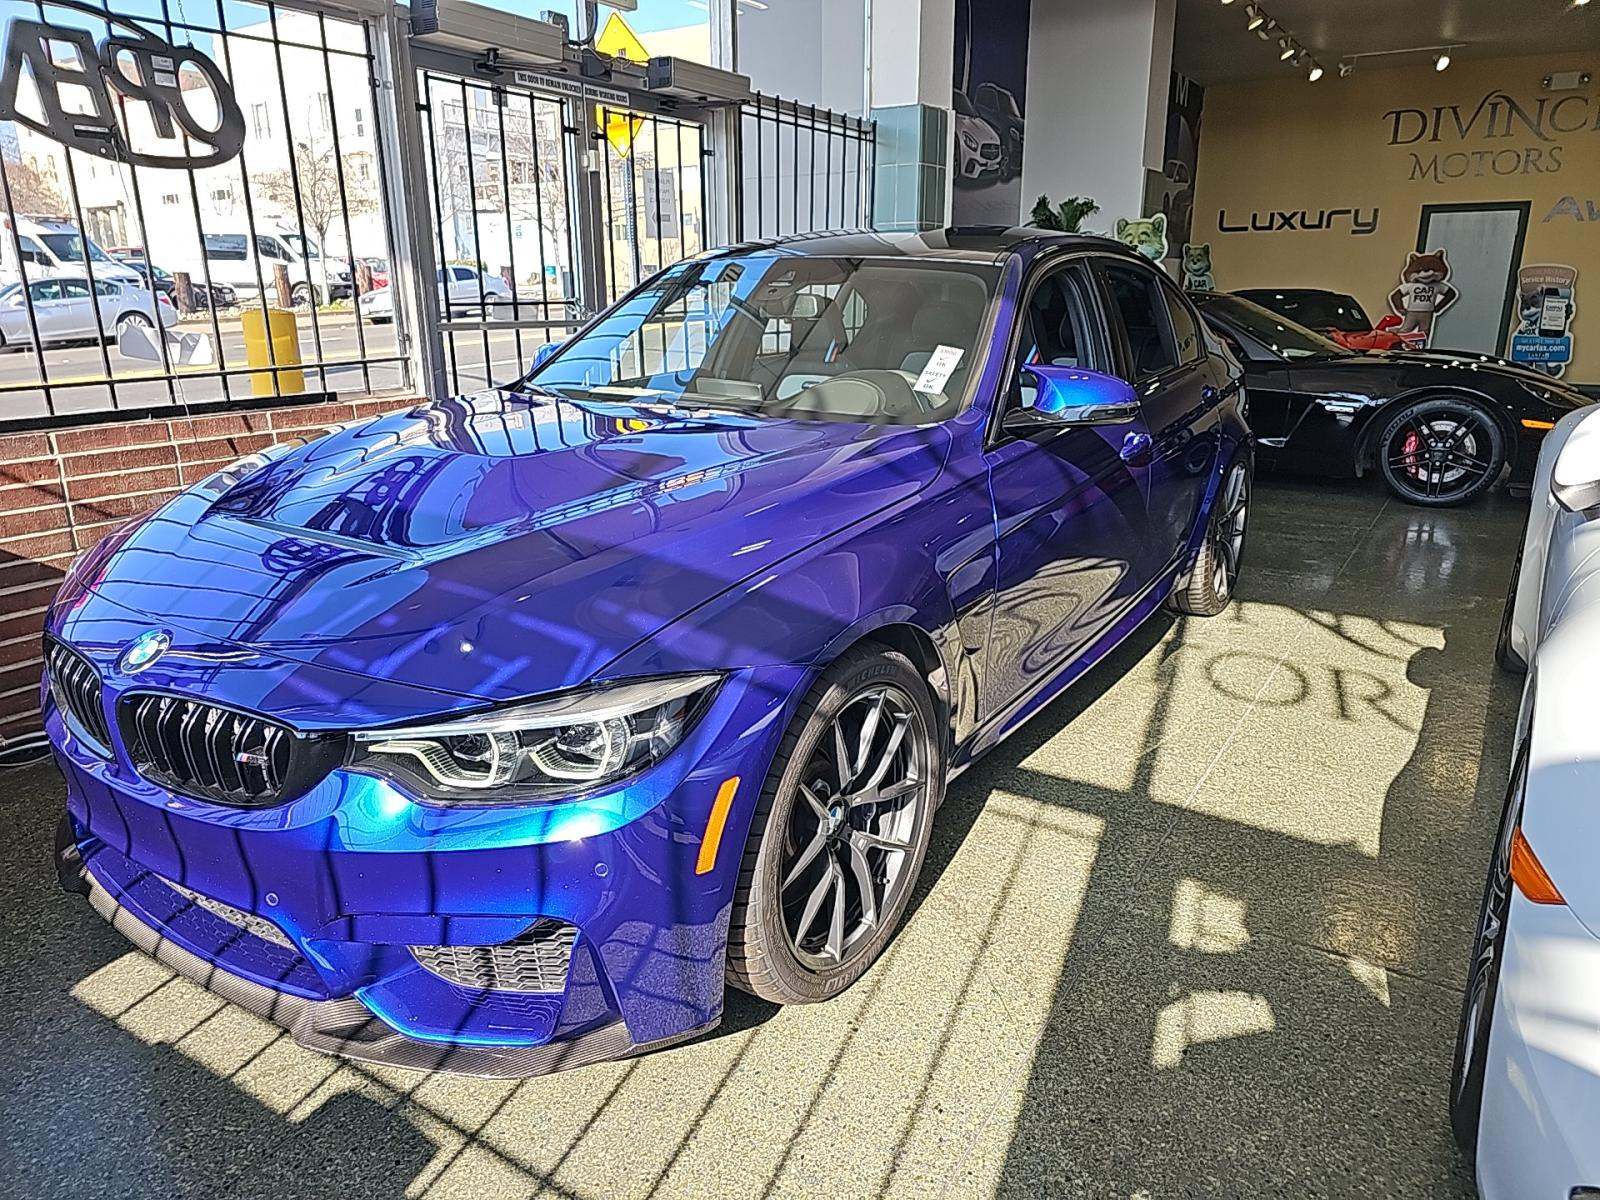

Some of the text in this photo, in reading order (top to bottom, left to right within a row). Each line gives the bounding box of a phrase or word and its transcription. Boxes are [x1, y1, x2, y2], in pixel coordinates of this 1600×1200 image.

[517, 72, 527, 82] THIS
[527, 74, 539, 85] DOOR
[545, 77, 561, 90] REMAIN
[561, 81, 581, 94] UNLOCKED
[1408, 146, 1563, 184] MOTORS
[1218, 207, 1380, 235] Luxury
[1545, 275, 1571, 286] History
[1413, 286, 1435, 295] CAR
[1413, 294, 1433, 303] FOX
[1516, 343, 1566, 353] mycarfax.com
